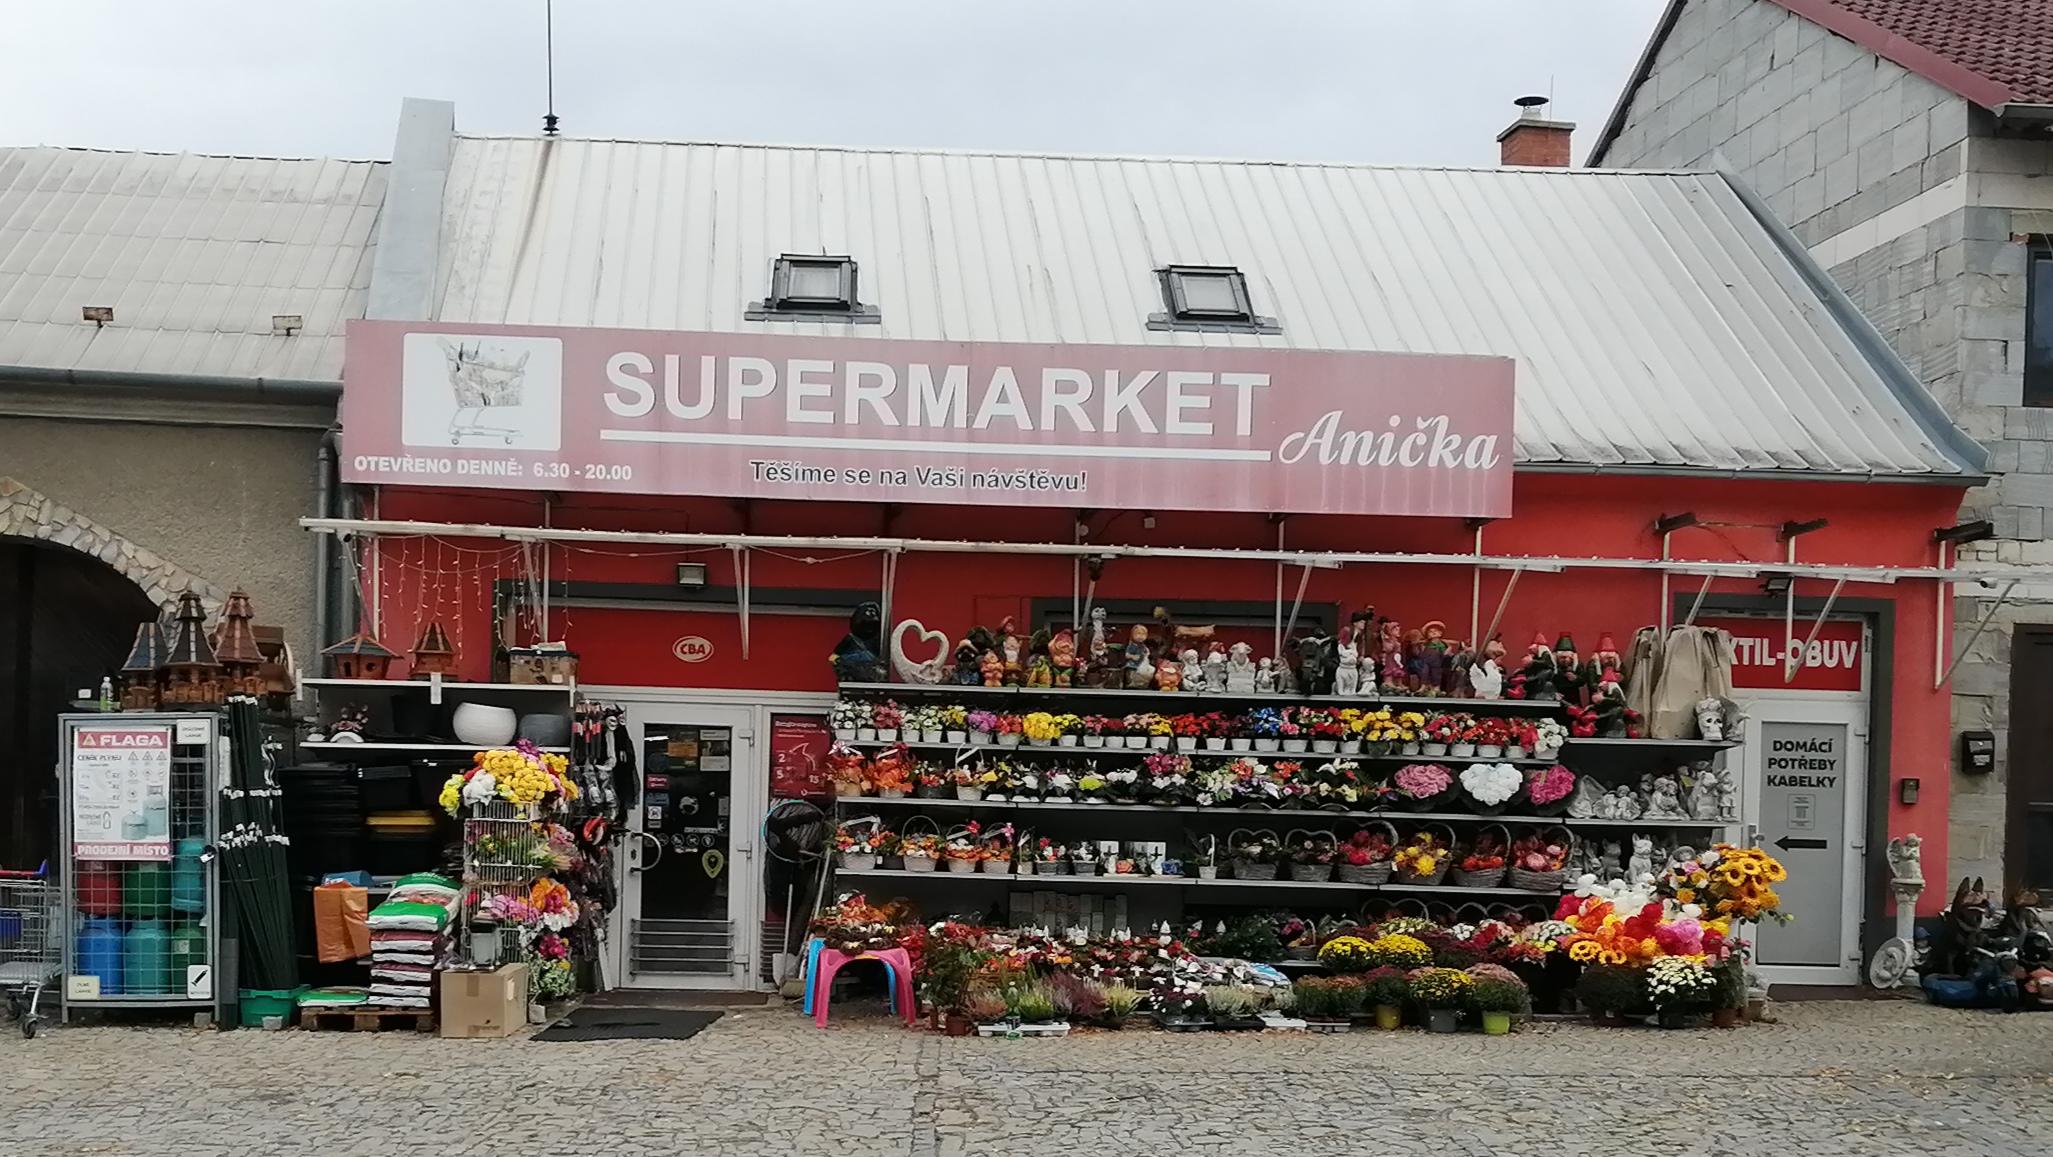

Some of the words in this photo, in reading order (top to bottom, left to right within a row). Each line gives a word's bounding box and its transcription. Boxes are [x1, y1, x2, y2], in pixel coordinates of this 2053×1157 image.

[603, 352, 1271, 436] SUPERMARKET
[1279, 410, 1500, 470] Anička
[353, 454, 451, 474] OTEVŘENO
[457, 457, 523, 476] DENNĚ:
[533, 463, 570, 478] 6.30
[584, 464, 632, 480] 20.00
[750, 461, 836, 482] Těšíme
[844, 468, 871, 484] se
[880, 470, 907, 487] na
[915, 467, 965, 488] Vaši
[972, 471, 1087, 492] návštěvu!
[680, 643, 706, 655] CBA
[100, 735, 163, 747] FLAGA
[1773, 738, 1833, 753] DOMÁCÍ
[1768, 755, 1836, 770] POTŘEBY
[1767, 774, 1836, 788] KABELKY
[77, 843, 130, 856] PRODEJNÍ
[133, 844, 169, 856] MÍSTO
